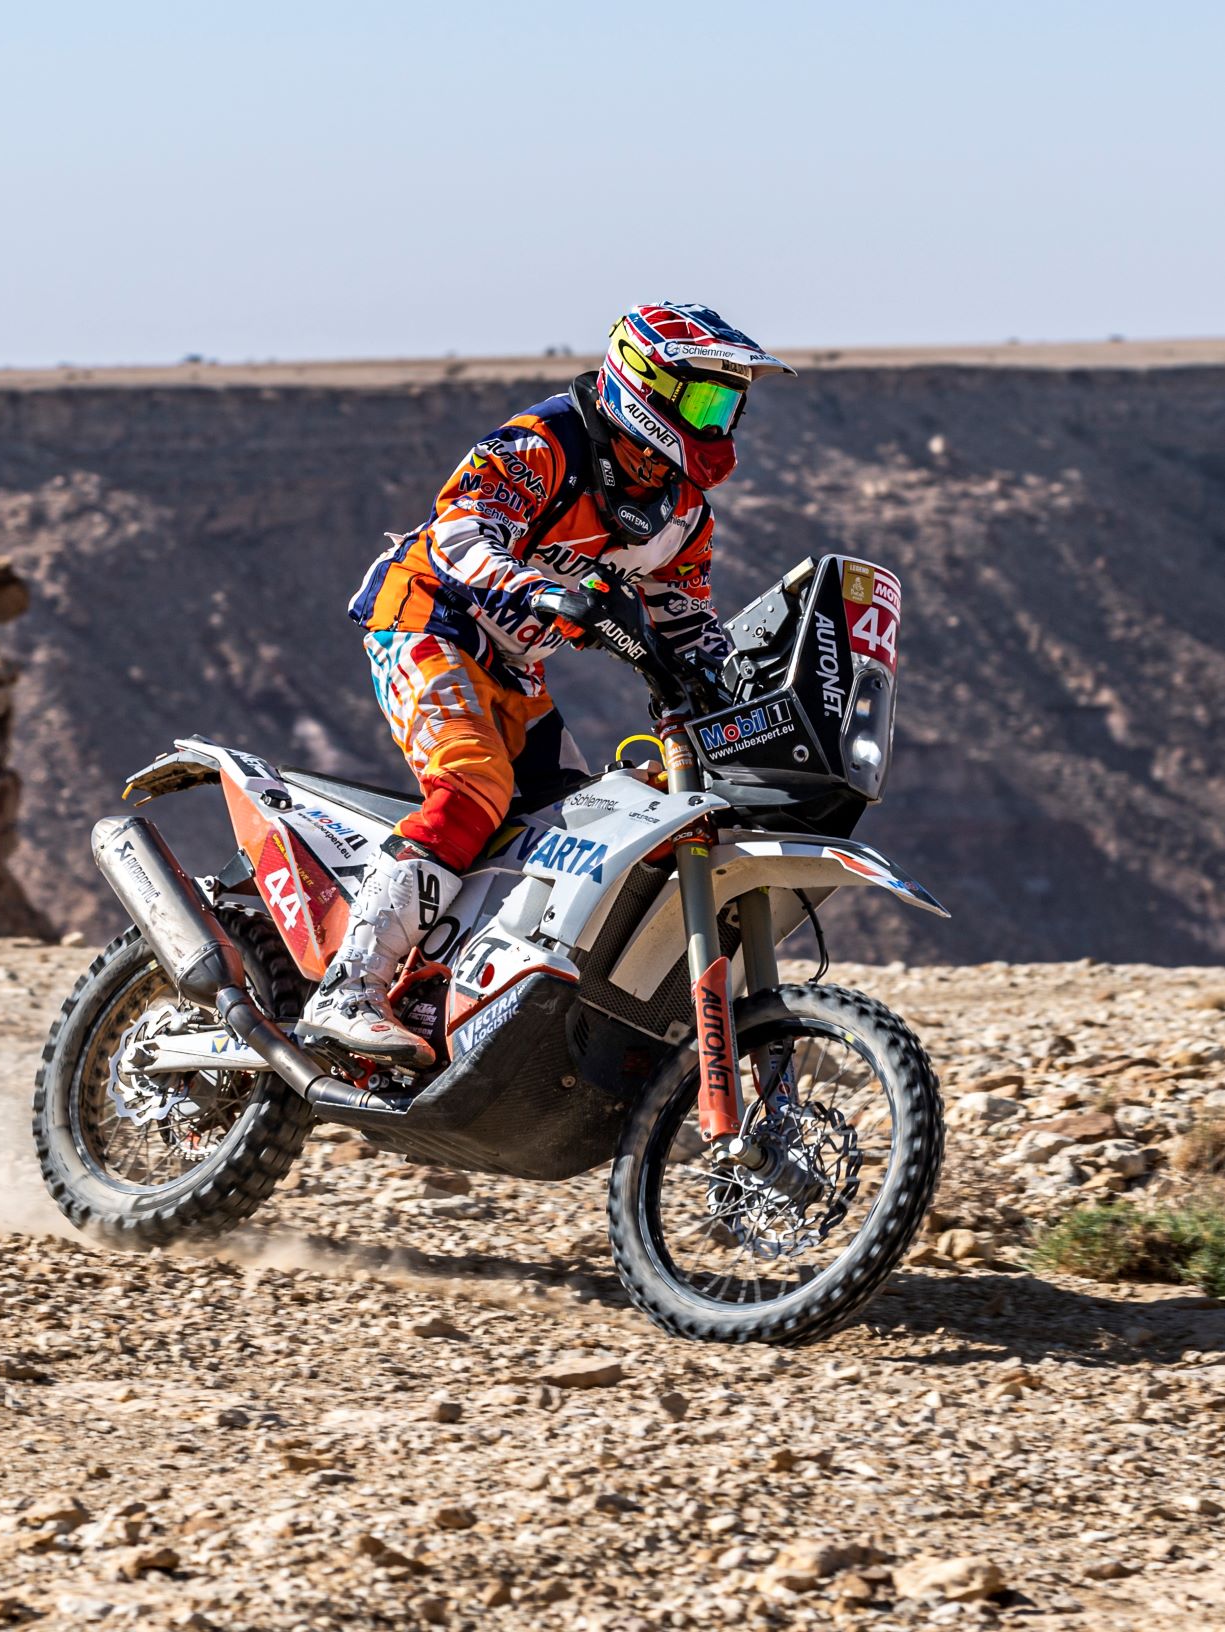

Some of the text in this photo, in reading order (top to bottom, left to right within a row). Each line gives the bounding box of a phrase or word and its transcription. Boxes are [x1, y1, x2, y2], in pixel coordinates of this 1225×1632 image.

[681, 345, 736, 359] Schlemmer
[624, 402, 678, 449] AUTONET
[480, 438, 549, 500] AUTONET
[620, 509, 650, 531] ORTEMA
[594, 618, 648, 660] AUTONET
[852, 606, 896, 664] 44
[699, 707, 768, 751] Mobil
[708, 723, 795, 761] www.lubexpert.eu
[306, 811, 354, 836] Mobil
[570, 793, 619, 811] Schlemmer
[517, 826, 609, 884] VARTA
[264, 867, 302, 931] 44
[459, 992, 518, 1053] VECTRA
